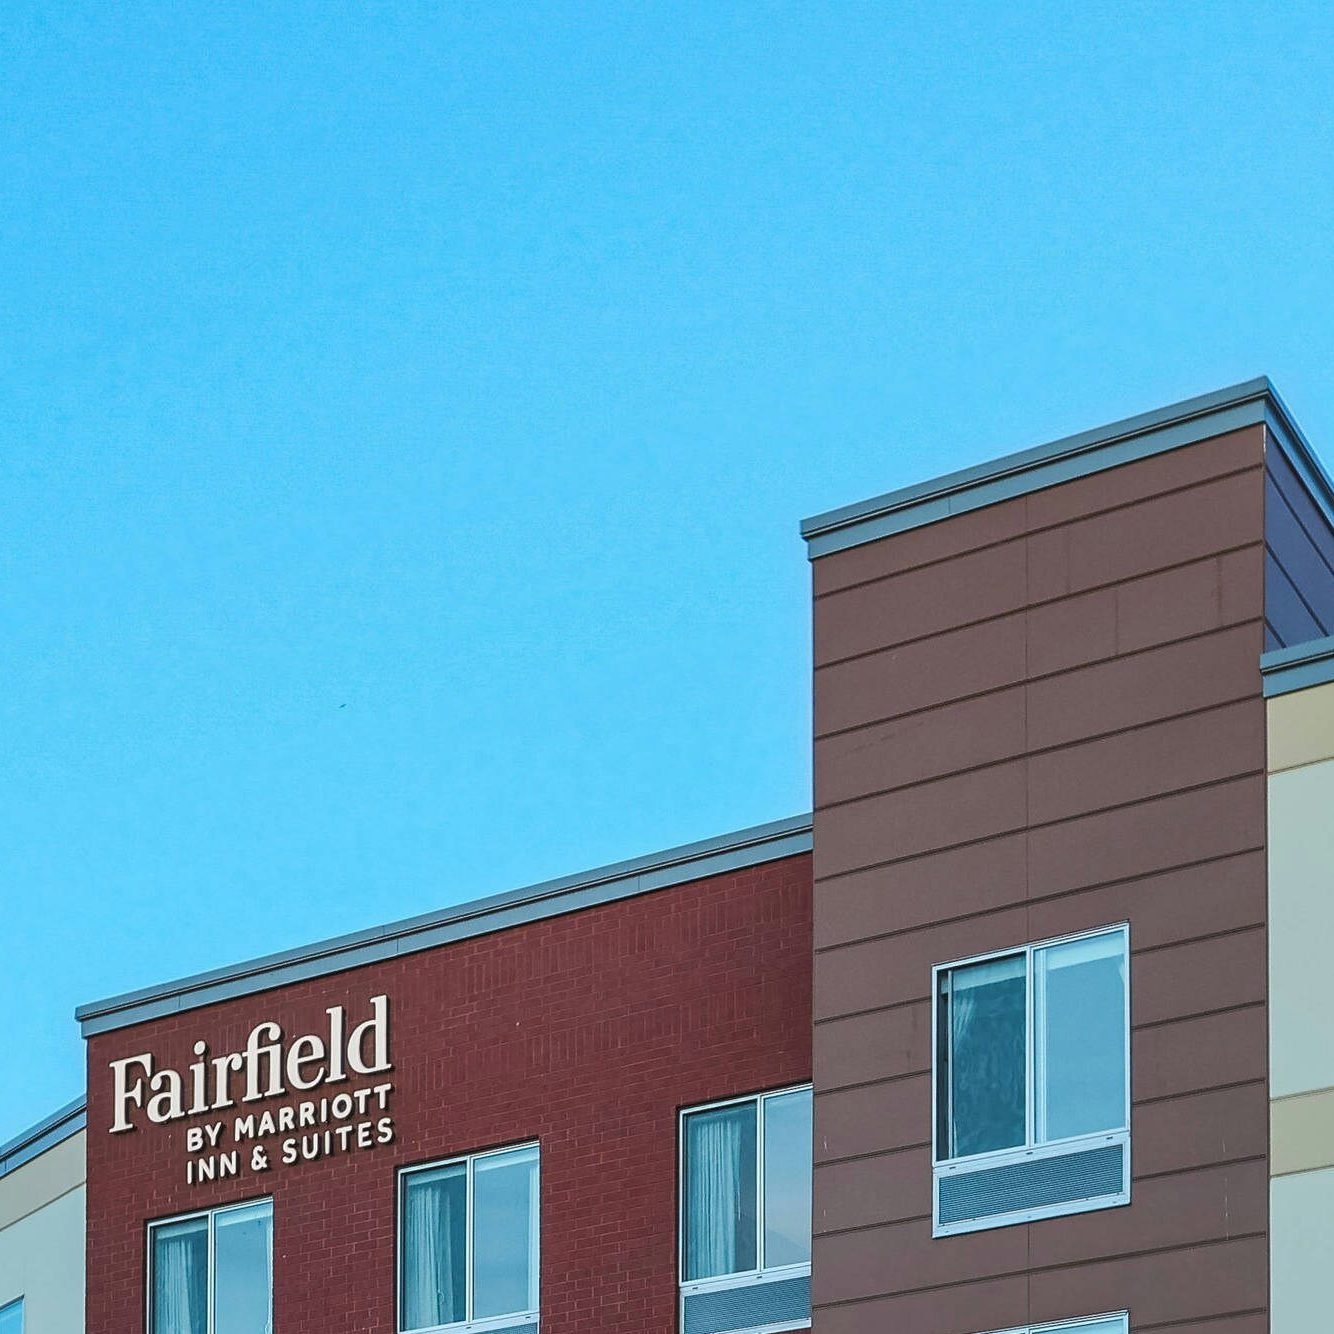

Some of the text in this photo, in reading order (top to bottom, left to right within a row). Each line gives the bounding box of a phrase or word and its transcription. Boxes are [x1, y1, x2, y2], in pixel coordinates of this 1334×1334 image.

[108, 994, 392, 1133] Fairfield
[186, 1083, 392, 1152] BY MARRIOTT
[186, 1117, 393, 1185] INN & SUITES
